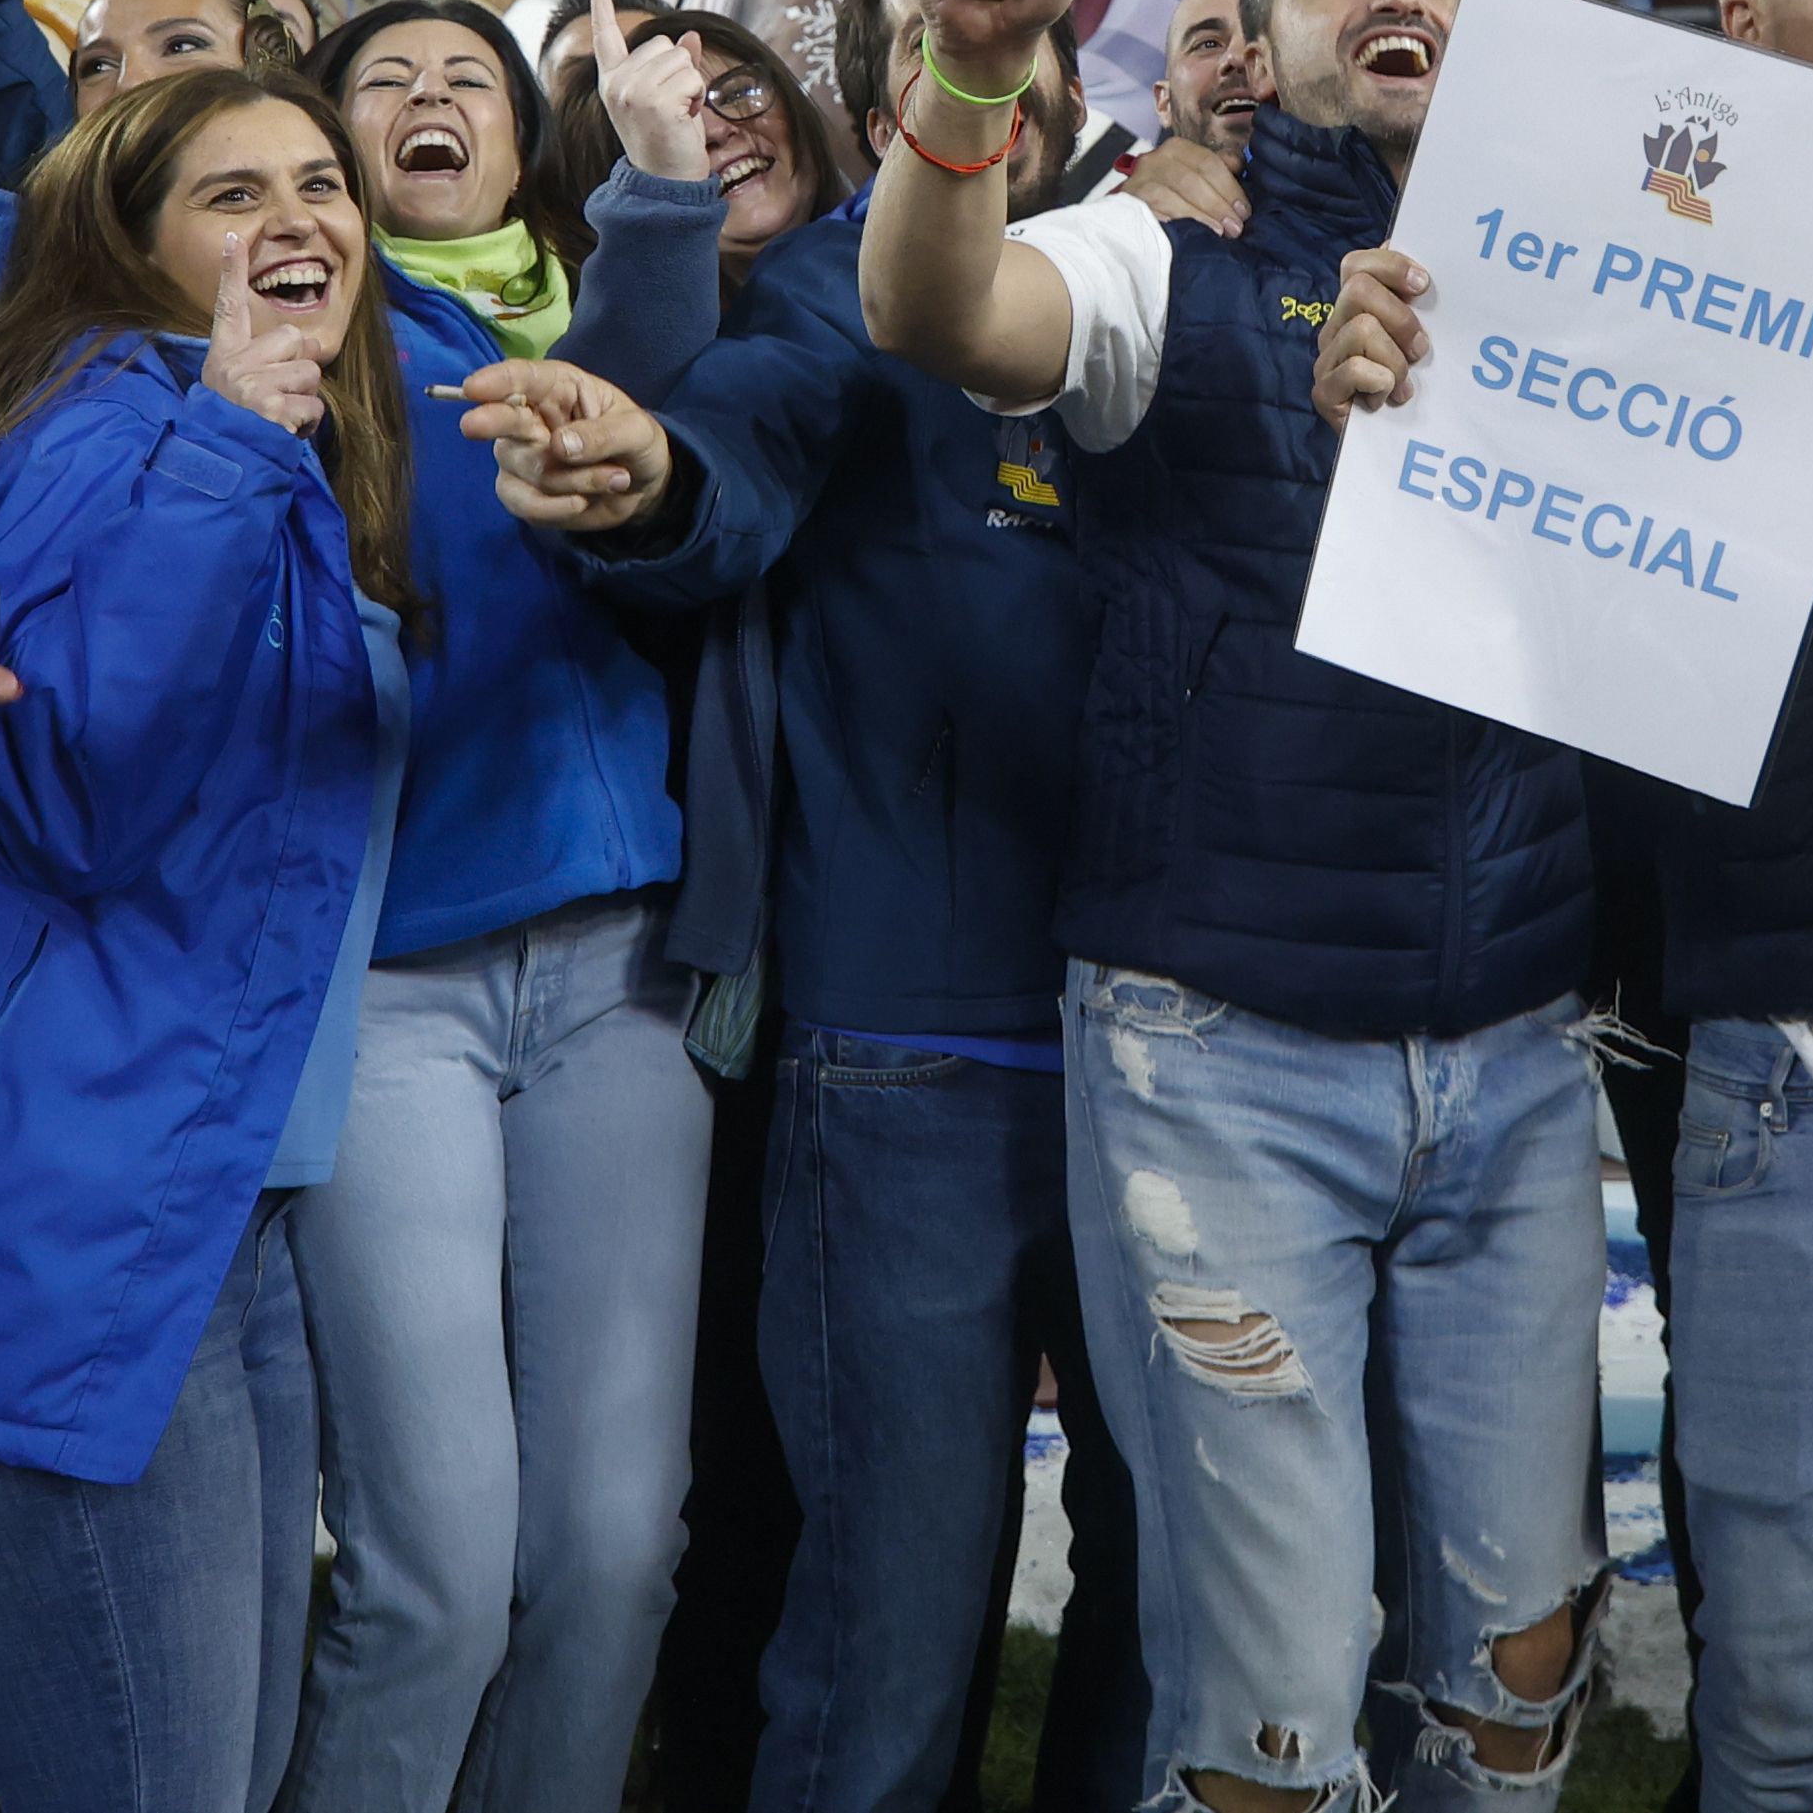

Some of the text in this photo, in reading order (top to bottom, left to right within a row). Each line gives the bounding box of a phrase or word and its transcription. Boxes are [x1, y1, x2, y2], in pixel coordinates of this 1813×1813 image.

[1655, 87, 1739, 126] L'Antiga
[1476, 208, 1578, 280] 1er
[1472, 336, 1742, 461] SECCIÓ
[1398, 440, 1739, 601] ESPECIAL
